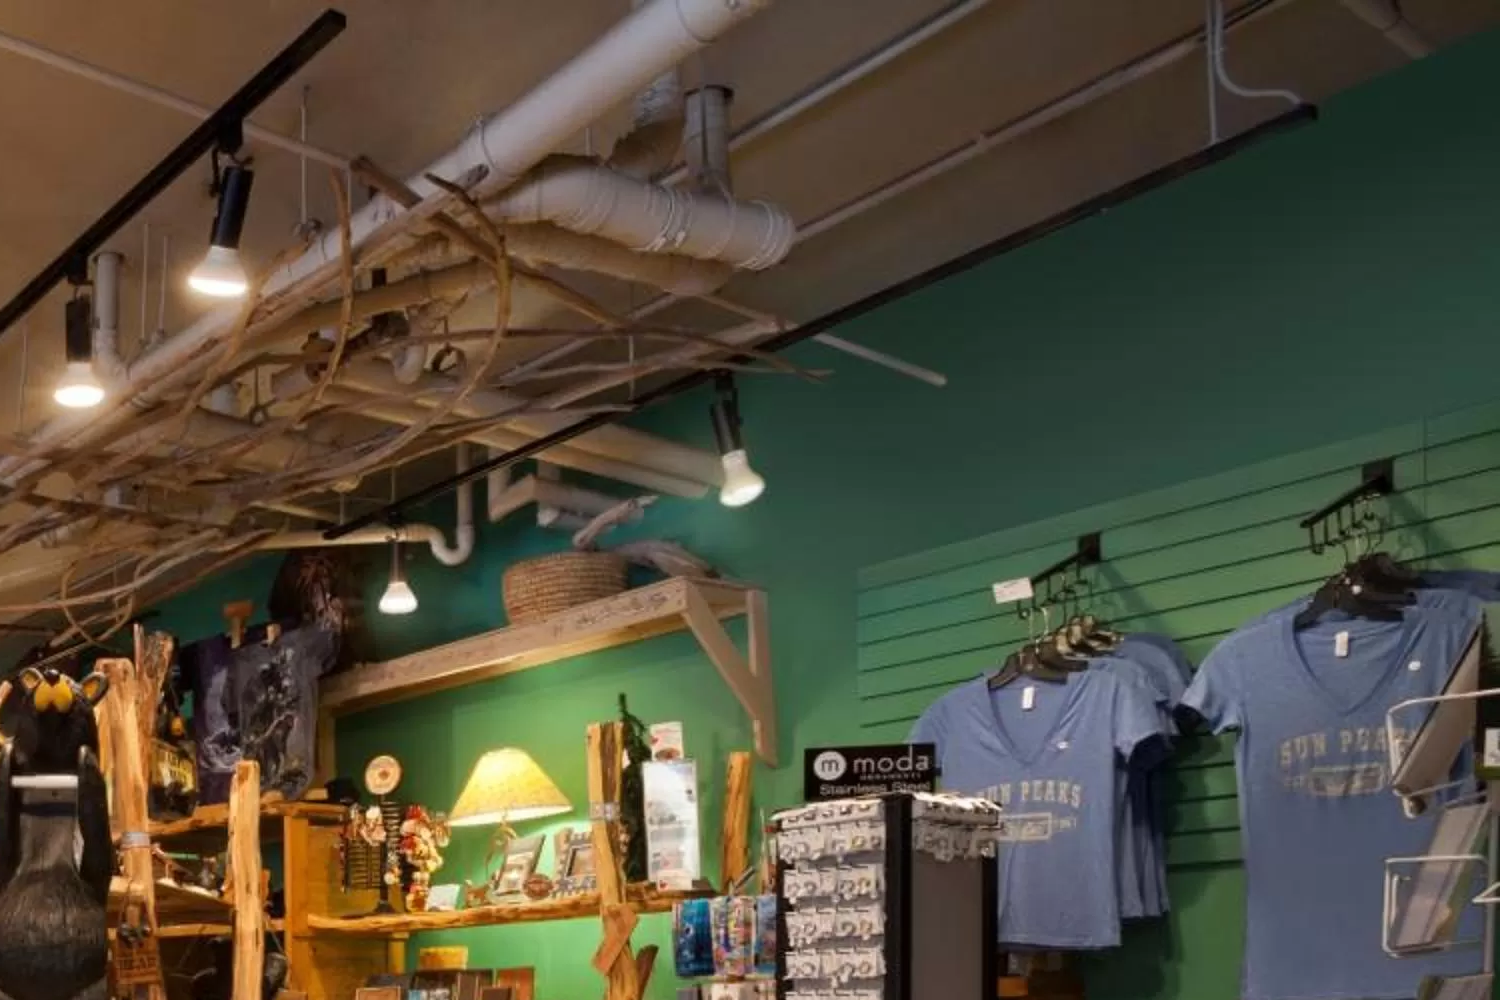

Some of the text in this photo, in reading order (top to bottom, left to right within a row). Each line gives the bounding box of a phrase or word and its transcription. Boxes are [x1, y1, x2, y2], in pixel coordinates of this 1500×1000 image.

[852, 745, 930, 774] moda
[1279, 735, 1327, 765] SUN
[819, 780, 931, 797] Stainless Steel
[1020, 779, 1081, 809] PEAKS
